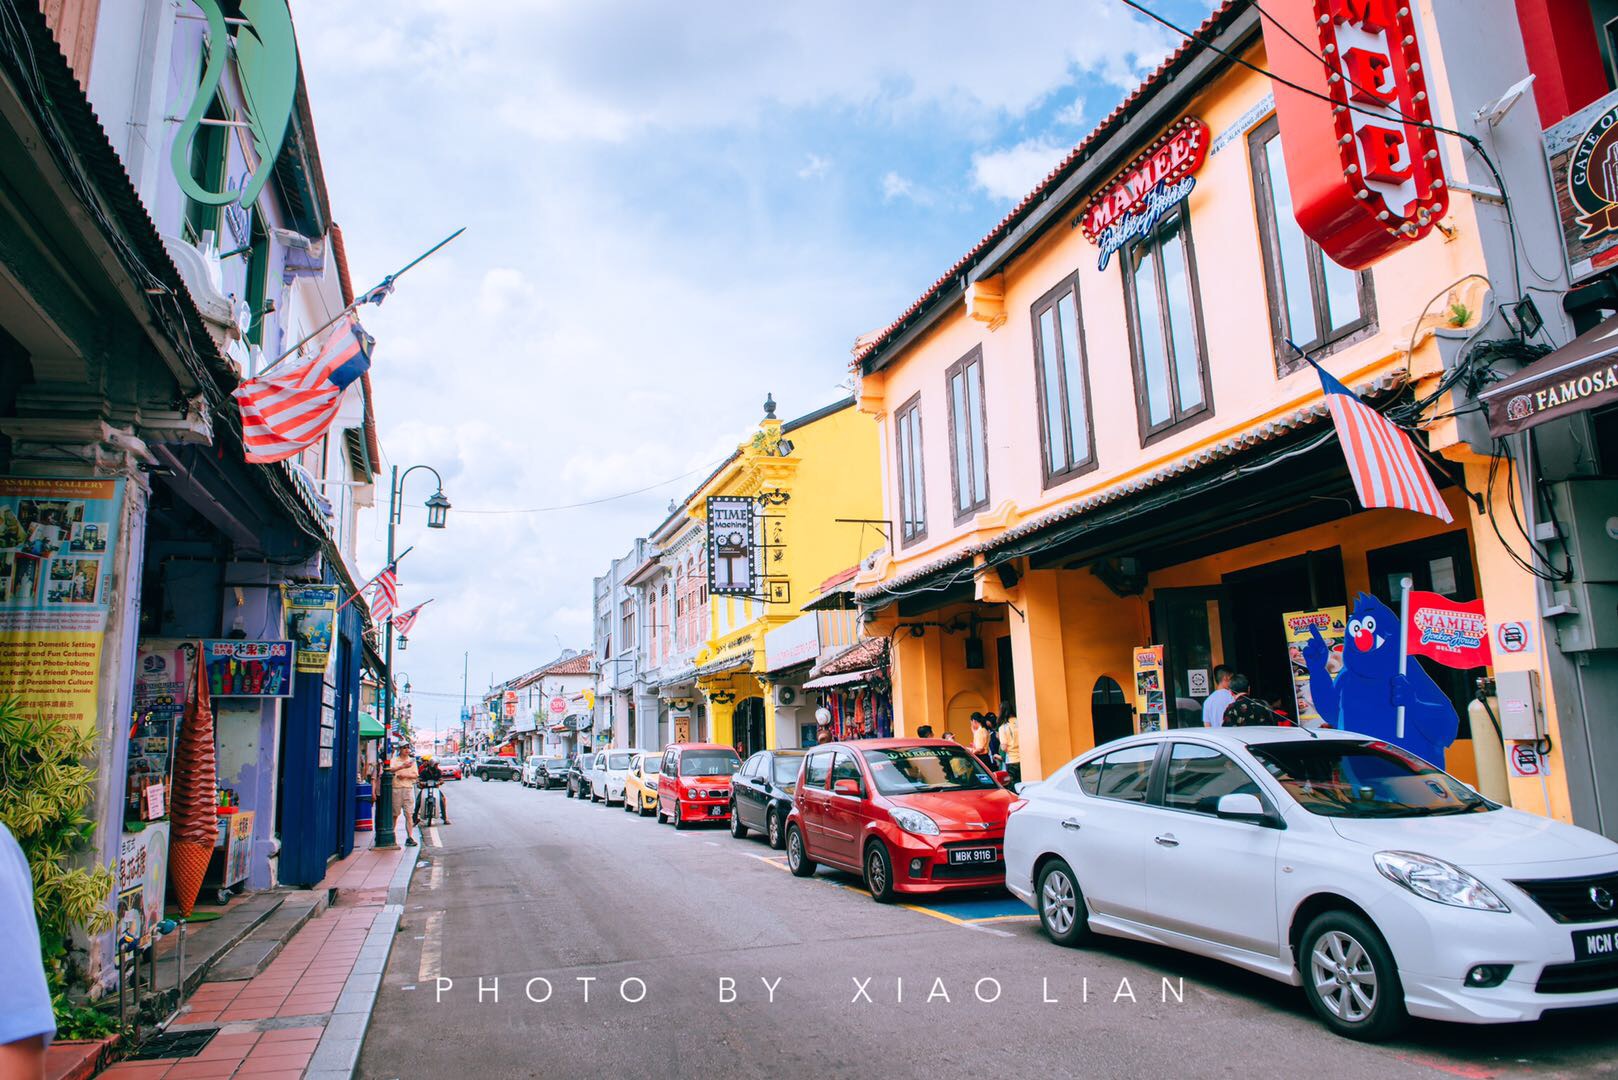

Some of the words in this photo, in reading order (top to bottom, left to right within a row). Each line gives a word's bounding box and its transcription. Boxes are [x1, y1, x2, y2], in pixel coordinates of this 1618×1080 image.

[1574, 132, 1600, 187] GATE
[1091, 129, 1191, 234] MAMEE
[1536, 366, 1618, 412] FAMOSA
[55, 480, 106, 489] GALLERY
[714, 509, 747, 520] TIME
[714, 521, 747, 529] Machine
[1421, 613, 1482, 633] MAMEE
[1448, 630, 1481, 648] House
[71, 641, 96, 649] Setting
[10, 669, 34, 677] Family
[899, 750, 953, 758] HERBALIFE
[973, 850, 991, 860] 9116
[1586, 933, 1613, 955] MCN
